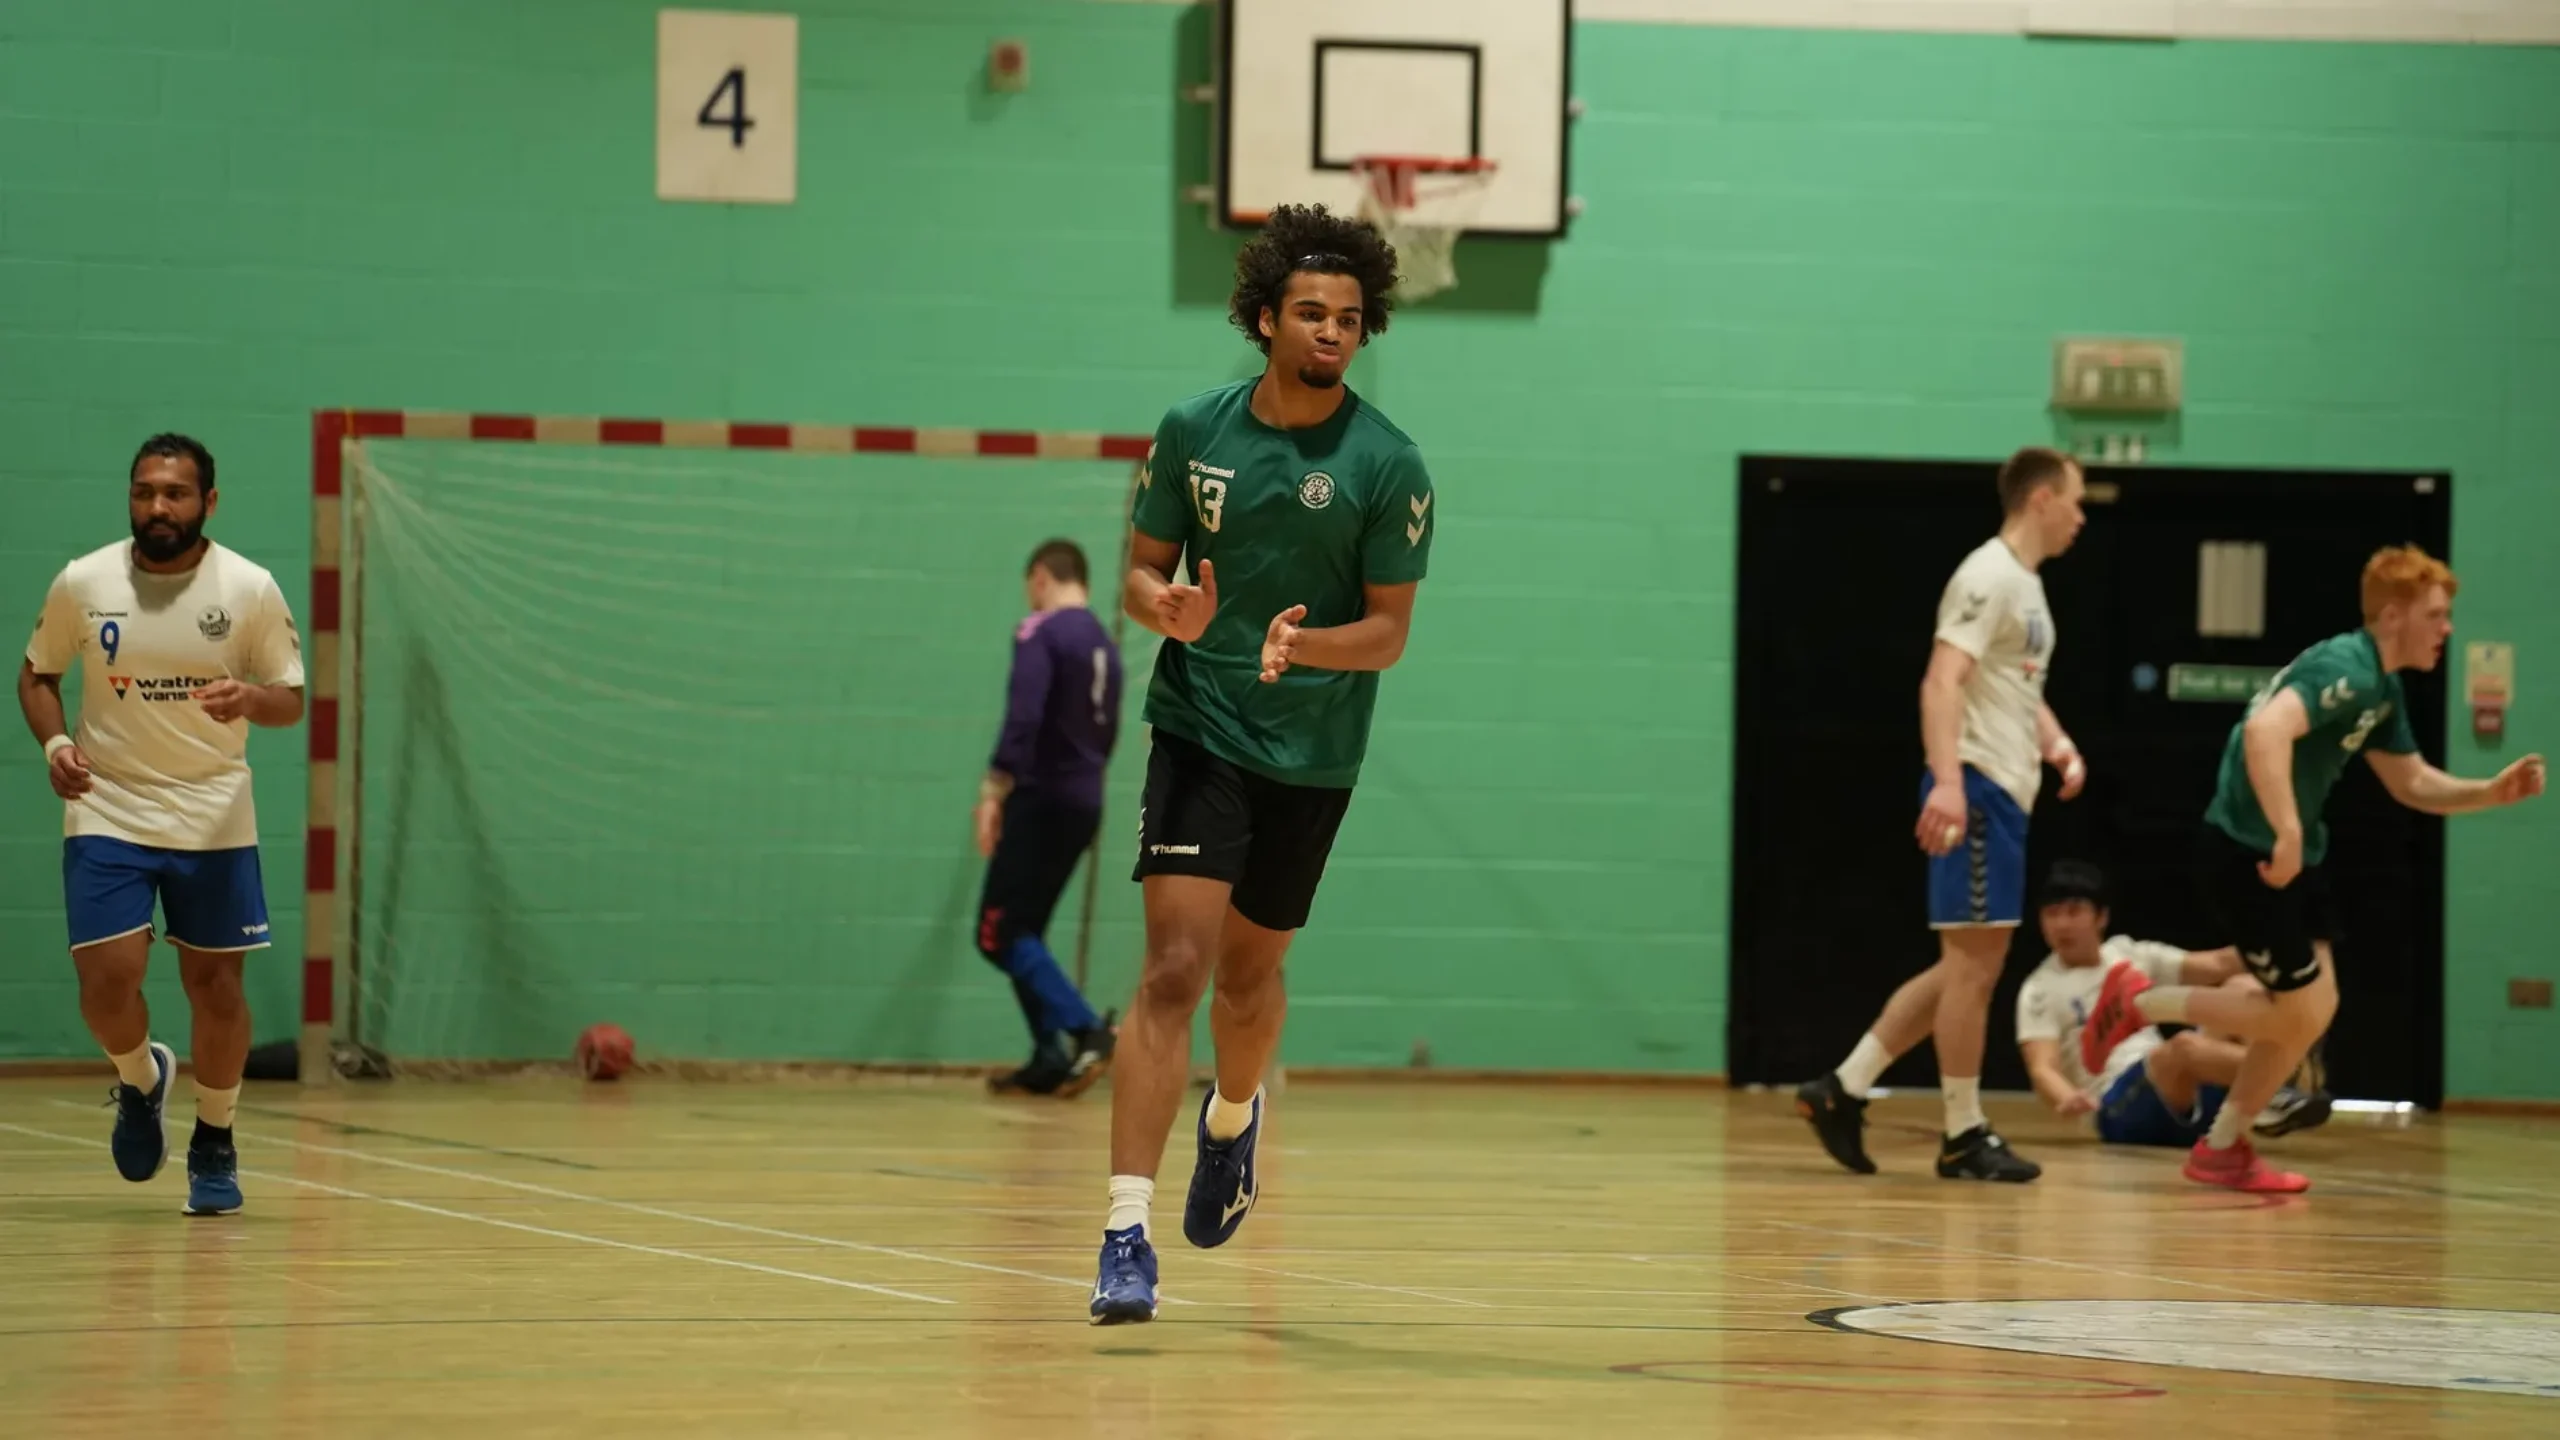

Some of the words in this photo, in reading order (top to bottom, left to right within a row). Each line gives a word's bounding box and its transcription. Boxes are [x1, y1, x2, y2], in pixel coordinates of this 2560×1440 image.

[698, 66, 755, 149] 4
[1198, 462, 1236, 479] hummel
[1189, 474, 1227, 533] 13
[100, 620, 120, 666] 9
[135, 675, 230, 689] watfo
[141, 691, 189, 701] vans
[1160, 844, 1199, 854] hummel
